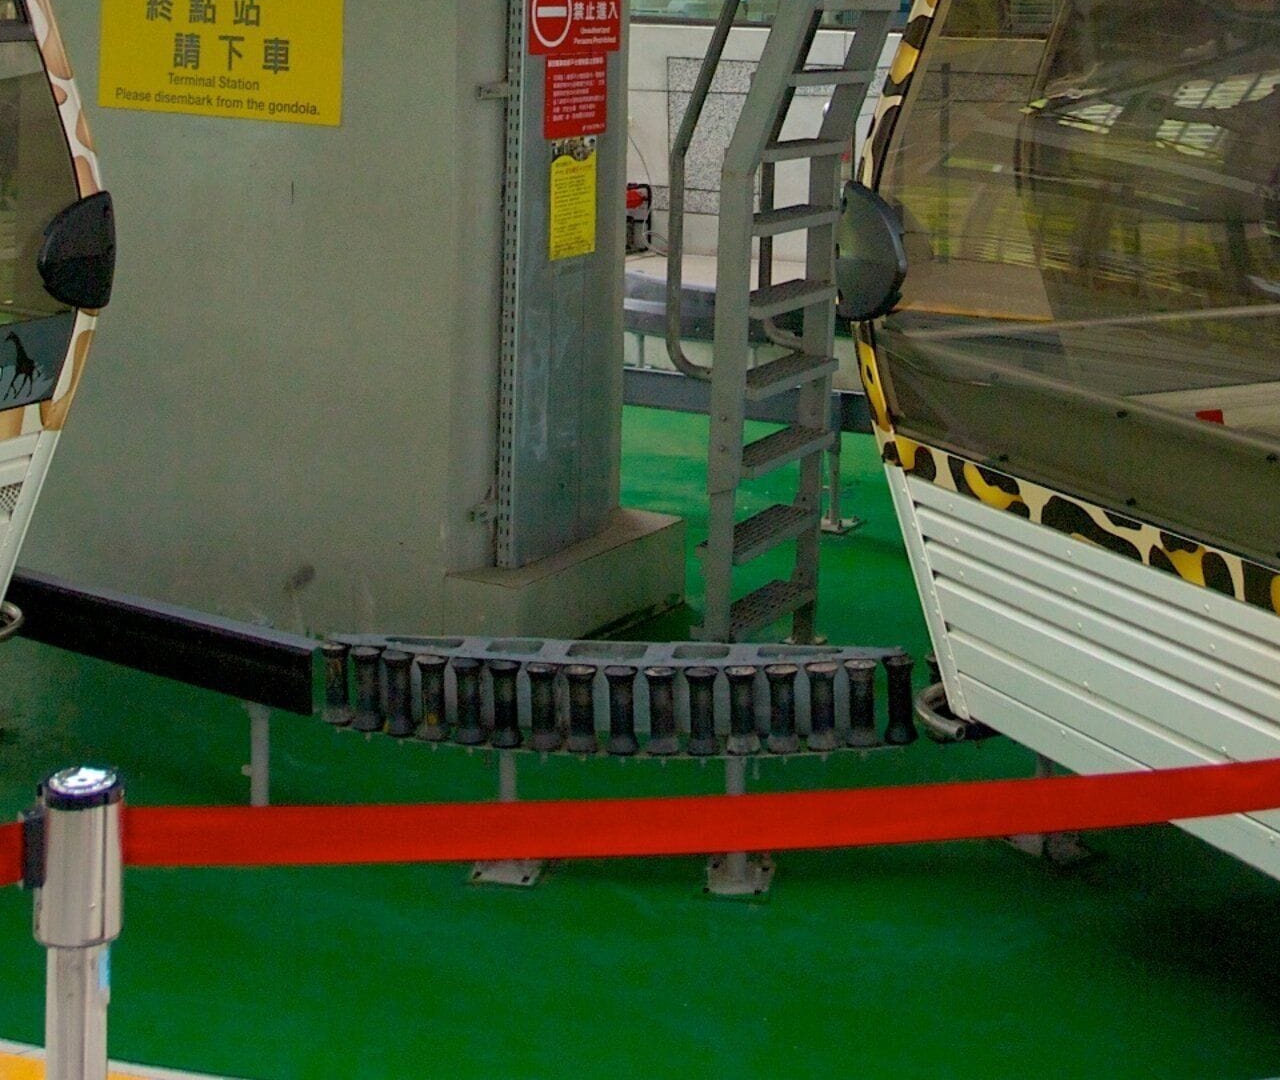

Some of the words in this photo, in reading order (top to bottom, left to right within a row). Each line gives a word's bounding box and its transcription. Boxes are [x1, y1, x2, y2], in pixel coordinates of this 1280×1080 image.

[573, 1, 619, 20] 禁止進入
[173, 33, 290, 74] 請下車
[168, 72, 216, 88] Terminal
[218, 76, 260, 91] Station
[115, 87, 152, 102] Please
[154, 91, 214, 107] disembark
[216, 96, 243, 109] from
[246, 99, 265, 111] the
[268, 101, 320, 116] gondola.
